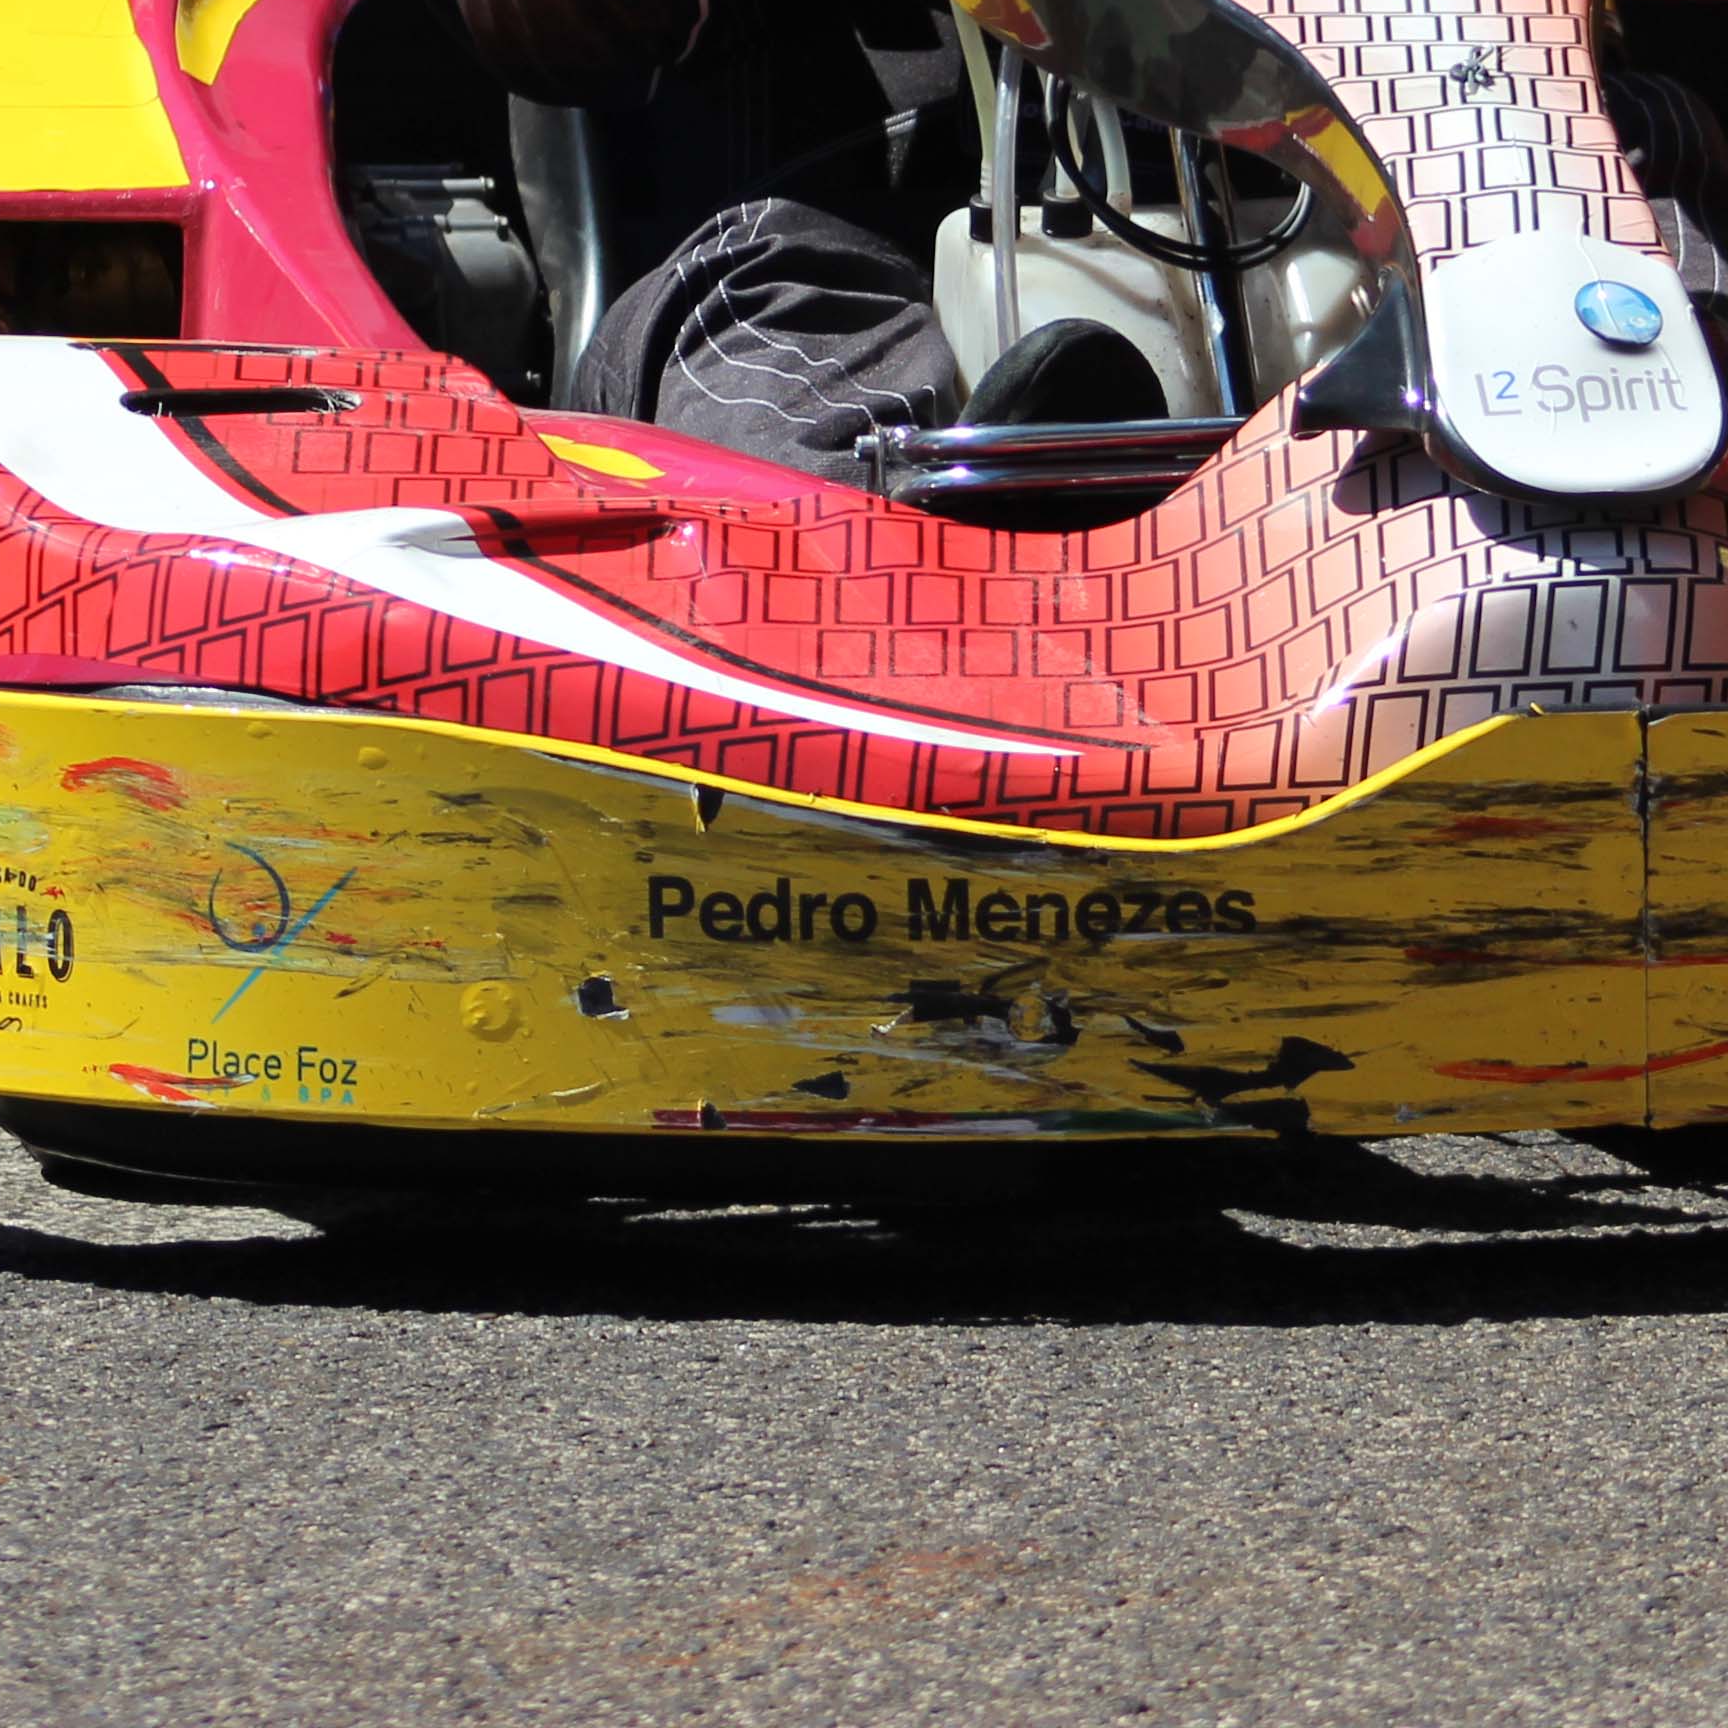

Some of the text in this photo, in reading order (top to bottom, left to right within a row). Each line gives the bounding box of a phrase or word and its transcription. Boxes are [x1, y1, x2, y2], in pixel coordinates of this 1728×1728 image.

[1529, 363, 1689, 425] Spirit
[17, 870, 38, 892] DO
[649, 875, 1257, 943] Pedro Menezes
[187, 1037, 358, 1086] Place Foz
